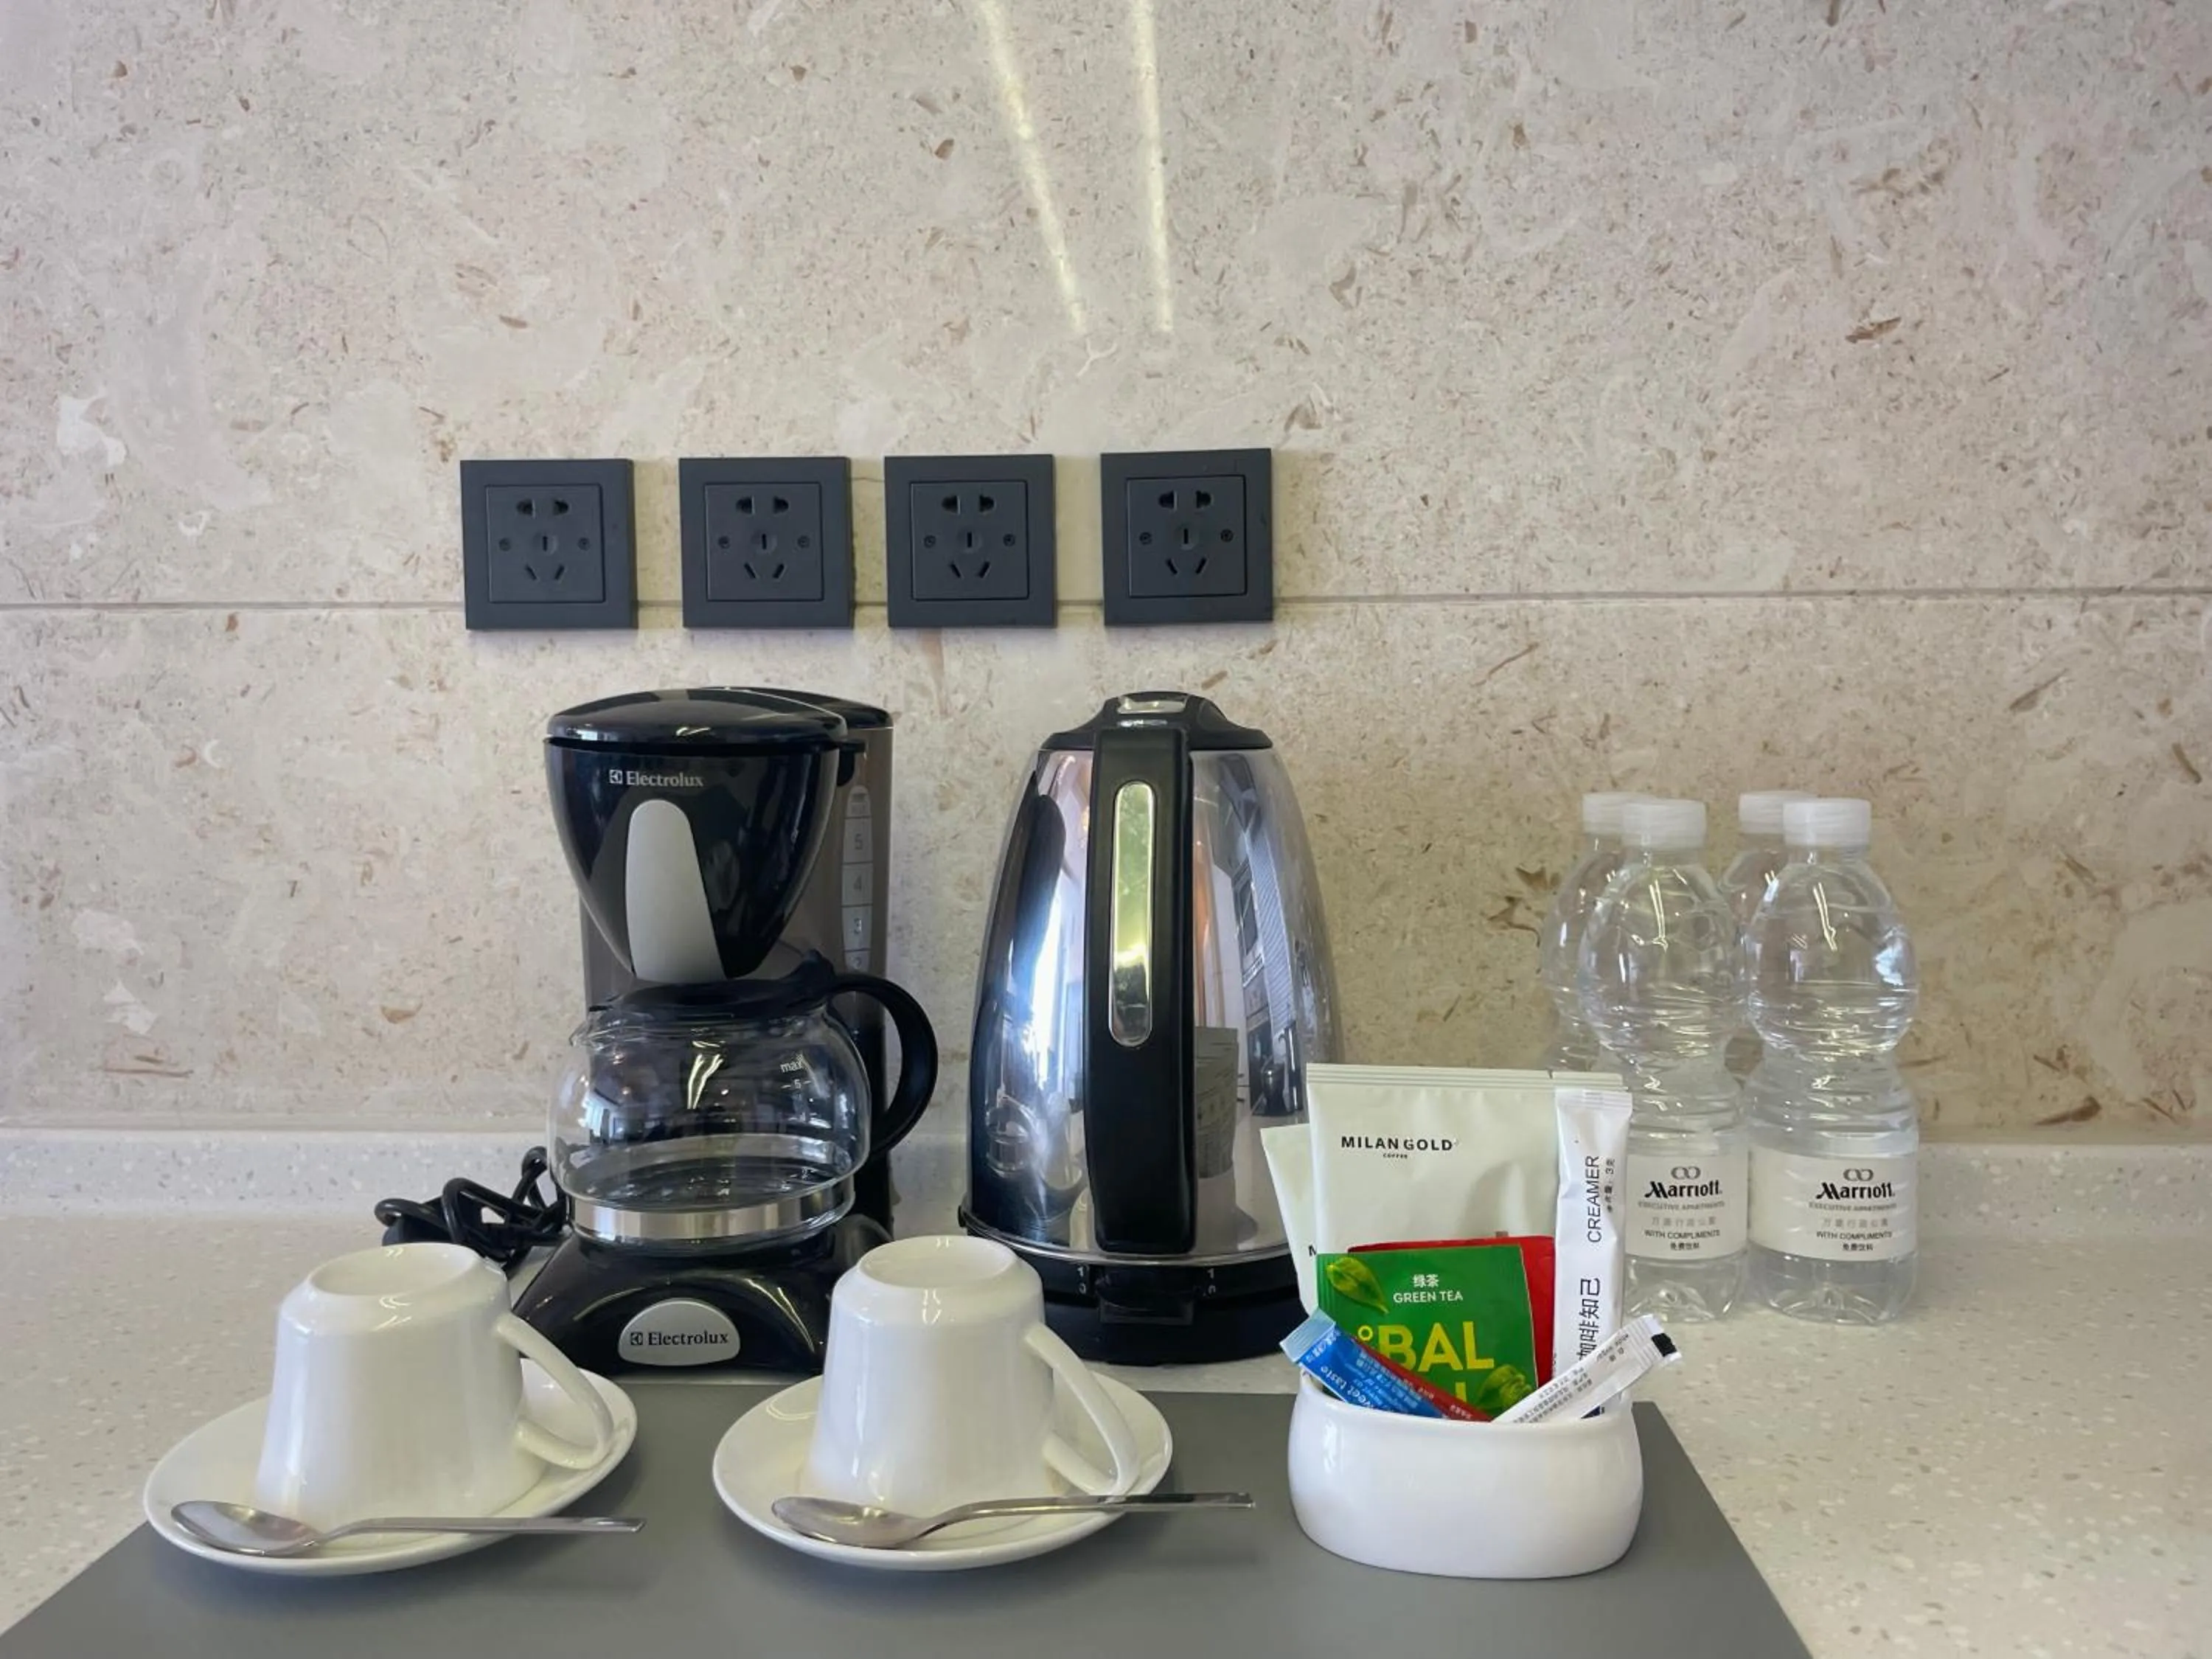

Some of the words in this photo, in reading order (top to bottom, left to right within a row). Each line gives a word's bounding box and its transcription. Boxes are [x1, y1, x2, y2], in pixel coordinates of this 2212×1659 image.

[626, 771, 704, 787] Electrolux
[854, 833, 863, 850] 5
[1340, 1135, 1399, 1150] MILAN
[1403, 1138, 1453, 1151] GOLD
[1644, 1180, 1719, 1199] Marriott
[1815, 1182, 1892, 1200] Marriott
[1585, 1155, 1601, 1243] CREAMER
[1644, 1229, 1665, 1238] WITH
[1667, 1229, 1720, 1239] COMPLIMENTS
[1816, 1231, 1837, 1239] WITH
[1839, 1231, 1893, 1240] COMPLIMENTS
[1413, 1273, 1439, 1288] 绿茶
[1393, 1291, 1436, 1304] GREEN
[1439, 1290, 1464, 1301] TEA
[648, 1329, 728, 1346] Electrolux
